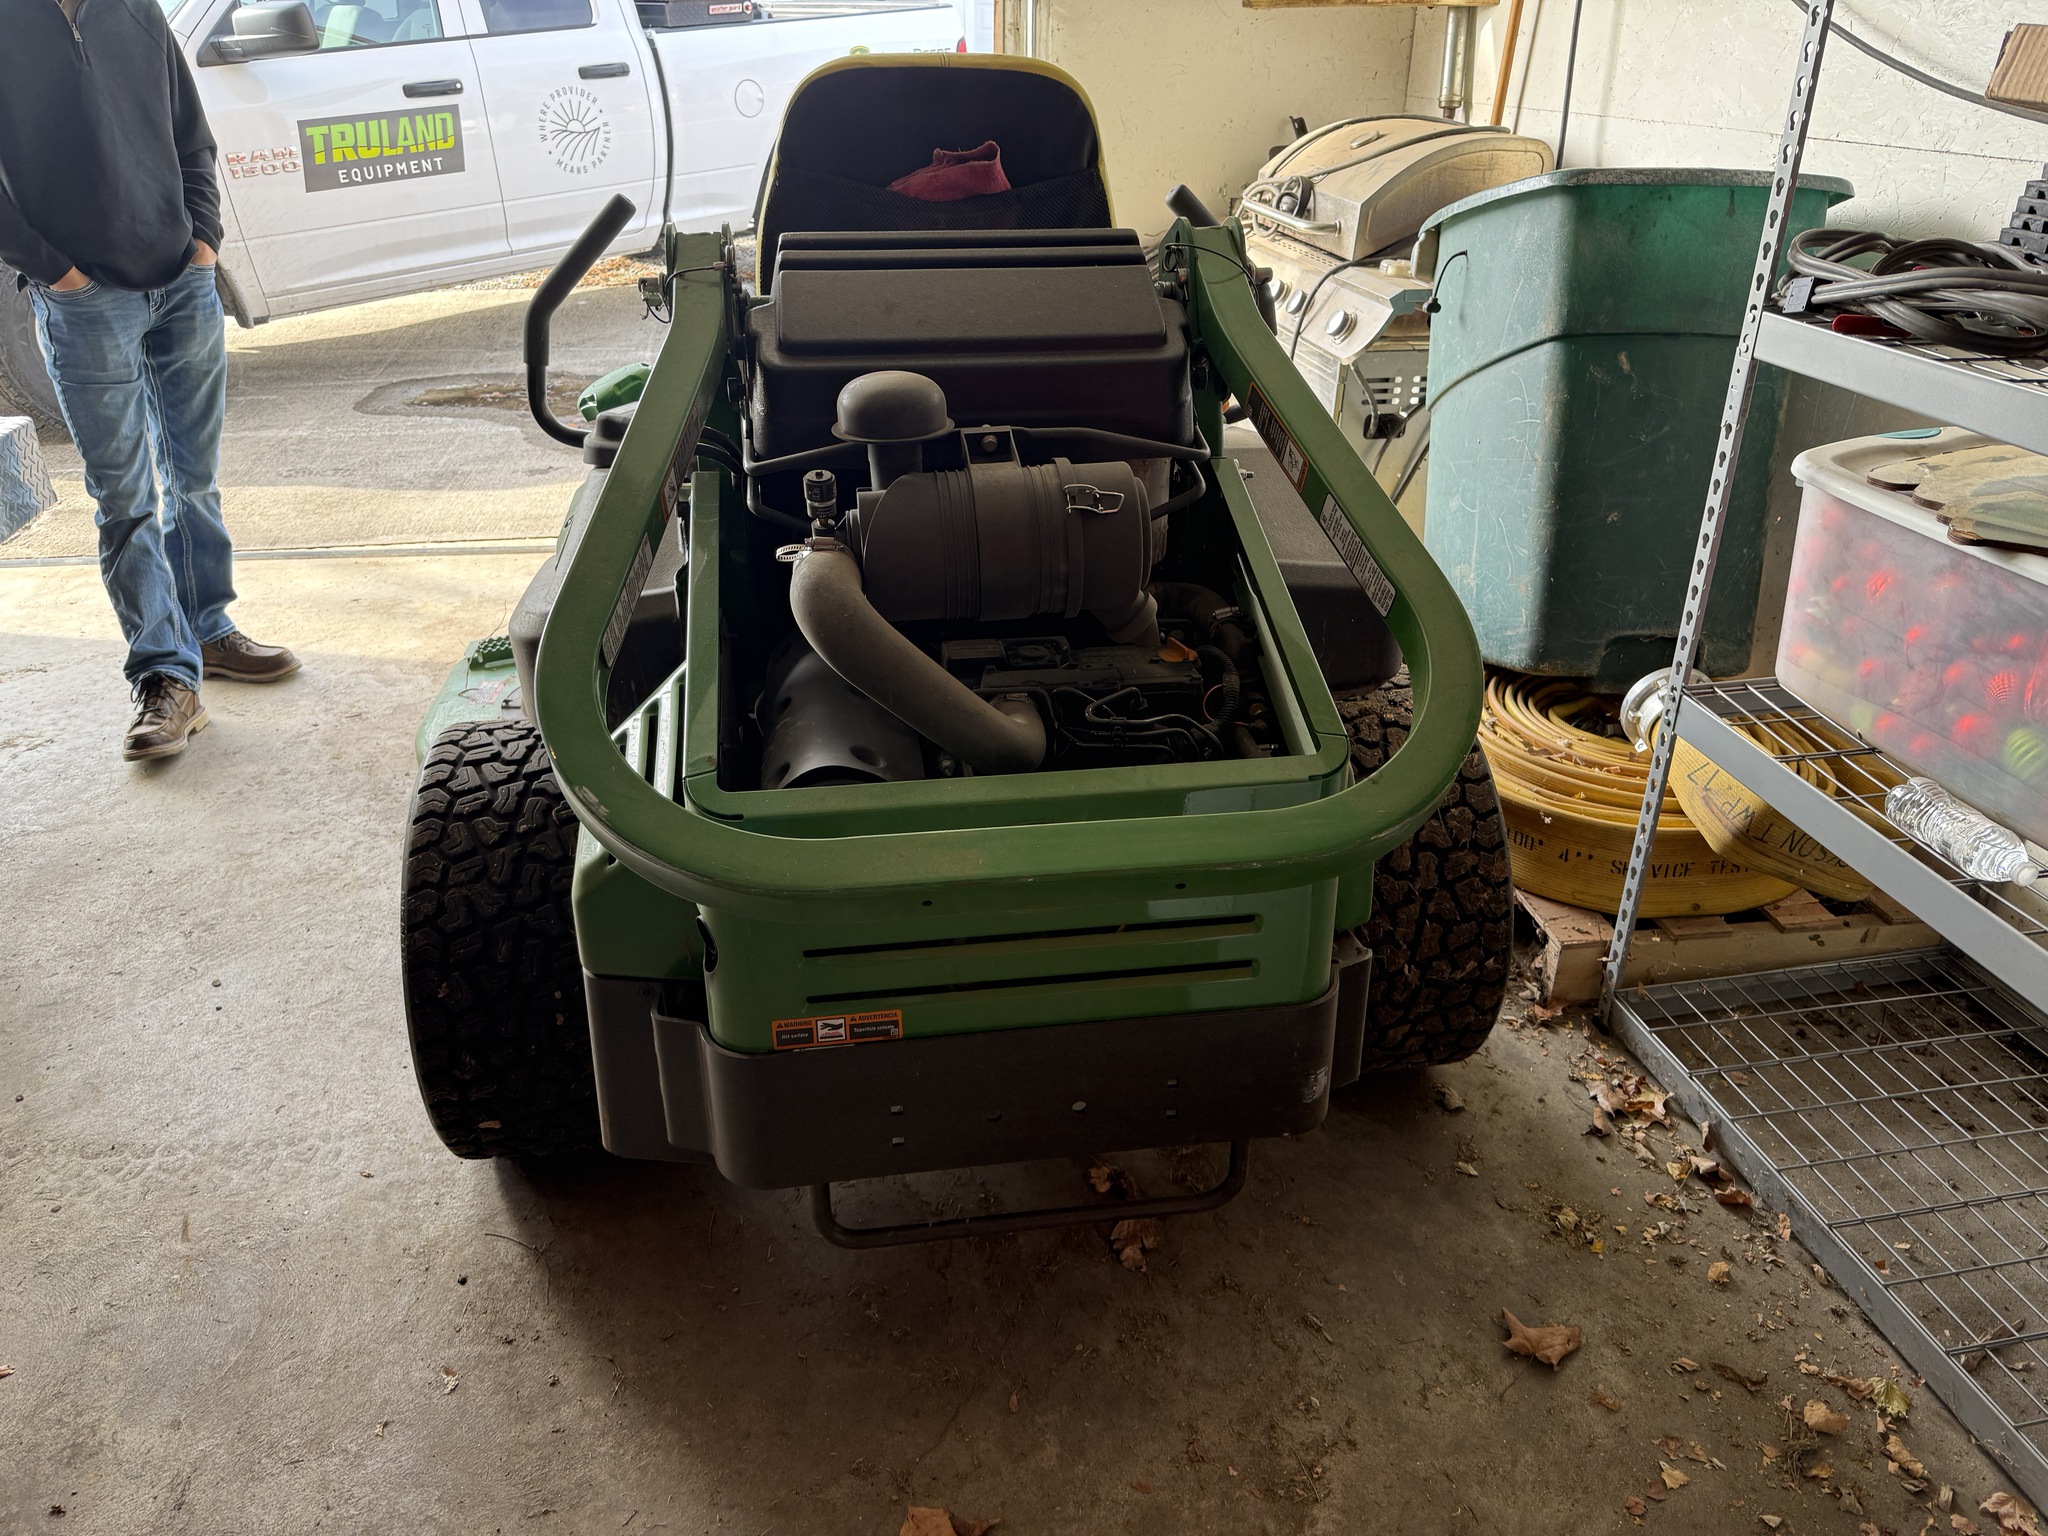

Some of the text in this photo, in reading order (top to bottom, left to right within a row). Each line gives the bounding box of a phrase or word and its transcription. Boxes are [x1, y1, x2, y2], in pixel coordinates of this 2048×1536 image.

[539, 85, 598, 142] WHERE PROVIDER
[306, 112, 455, 165] TRULAND
[556, 121, 611, 174] MEANS PARTNER
[225, 146, 298, 166] RAM
[230, 160, 301, 179] 1500
[338, 157, 443, 183] EQUIPMENT
[1687, 762, 1720, 791] 17
[1721, 797, 1774, 844] TWP
[1610, 859, 1696, 878] SEVICE
[1710, 860, 1749, 875] TES
[783, 1020, 812, 1028] WARNING
[858, 1012, 898, 1021] ADVERTENCIA
